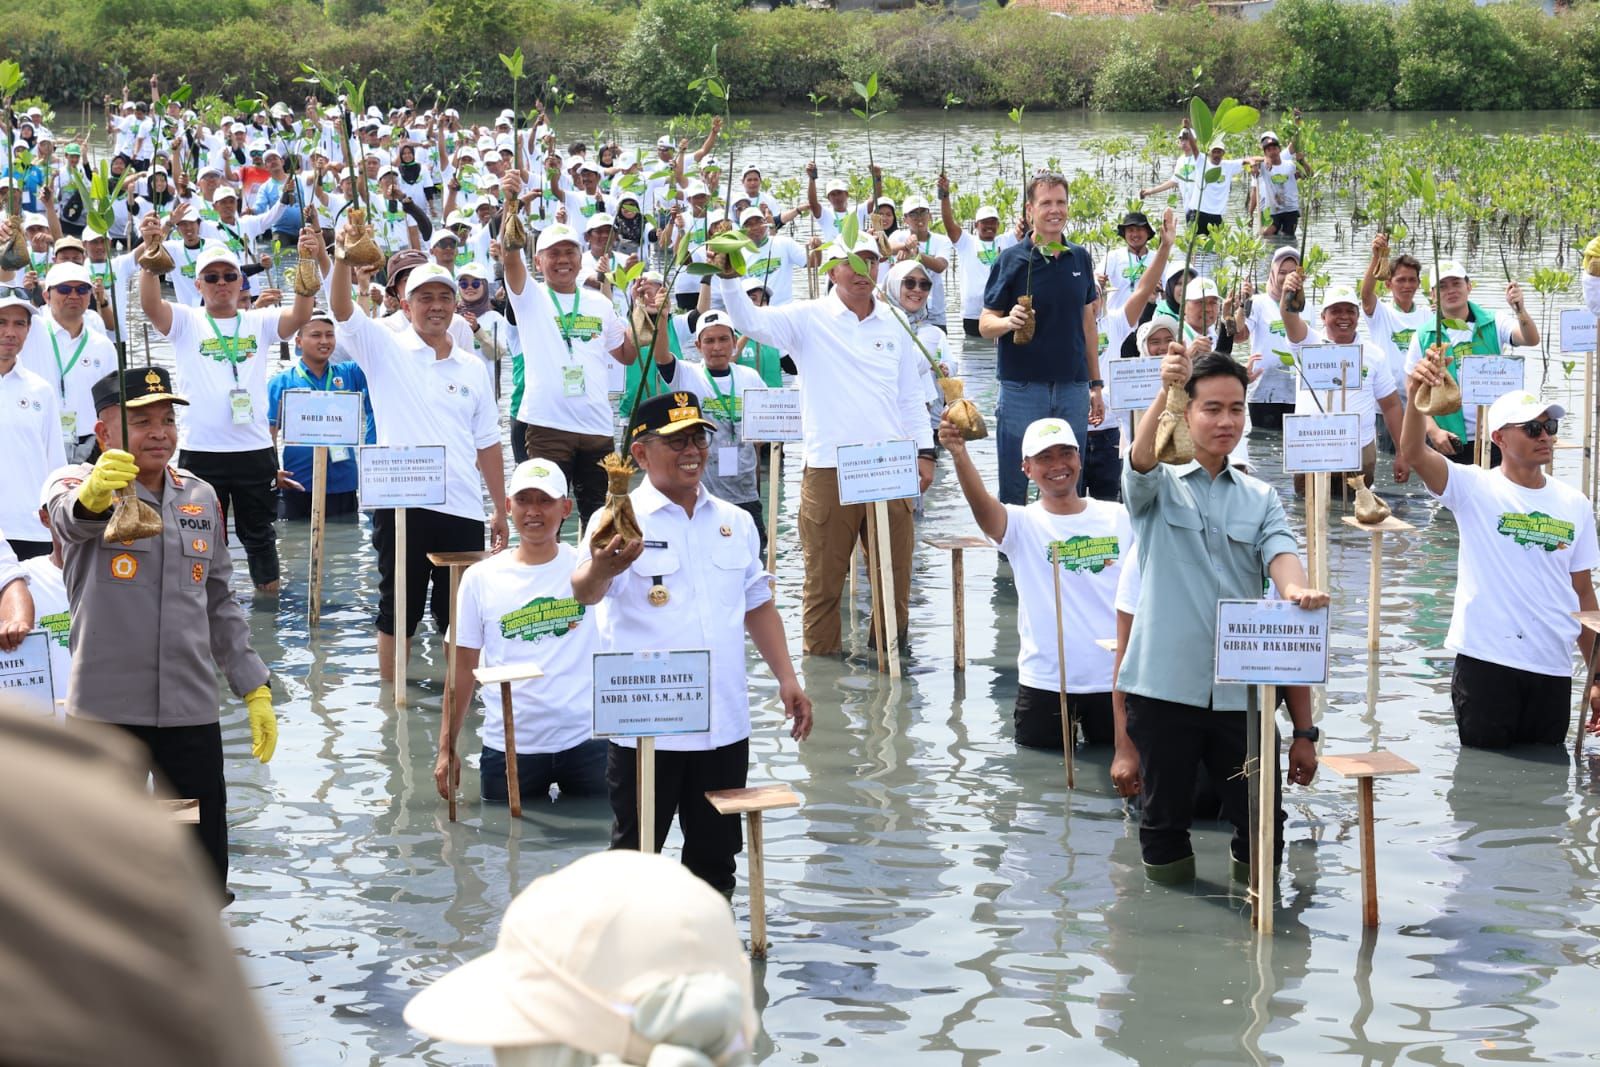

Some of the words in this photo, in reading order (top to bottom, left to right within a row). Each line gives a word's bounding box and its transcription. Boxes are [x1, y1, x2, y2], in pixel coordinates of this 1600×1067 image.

[301, 414, 324, 422] WORLD
[326, 415, 343, 423] BANK
[179, 518, 211, 531] POLRI
[505, 611, 542, 632] EKOSISTEM
[543, 605, 579, 621] MANGROVE
[1228, 623, 1257, 633] WAKIL
[1259, 624, 1305, 635] PRESIDEN
[1308, 625, 1320, 635] RI
[1223, 641, 1258, 650] GIBRAN
[1263, 641, 1321, 652] RAKABUMING
[611, 675, 656, 685] GUBERNUR
[660, 674, 694, 684] BANTEN
[601, 694, 628, 704] ANDRA
[631, 693, 654, 703] SONI,
[655, 692, 676, 702] S.M.,
